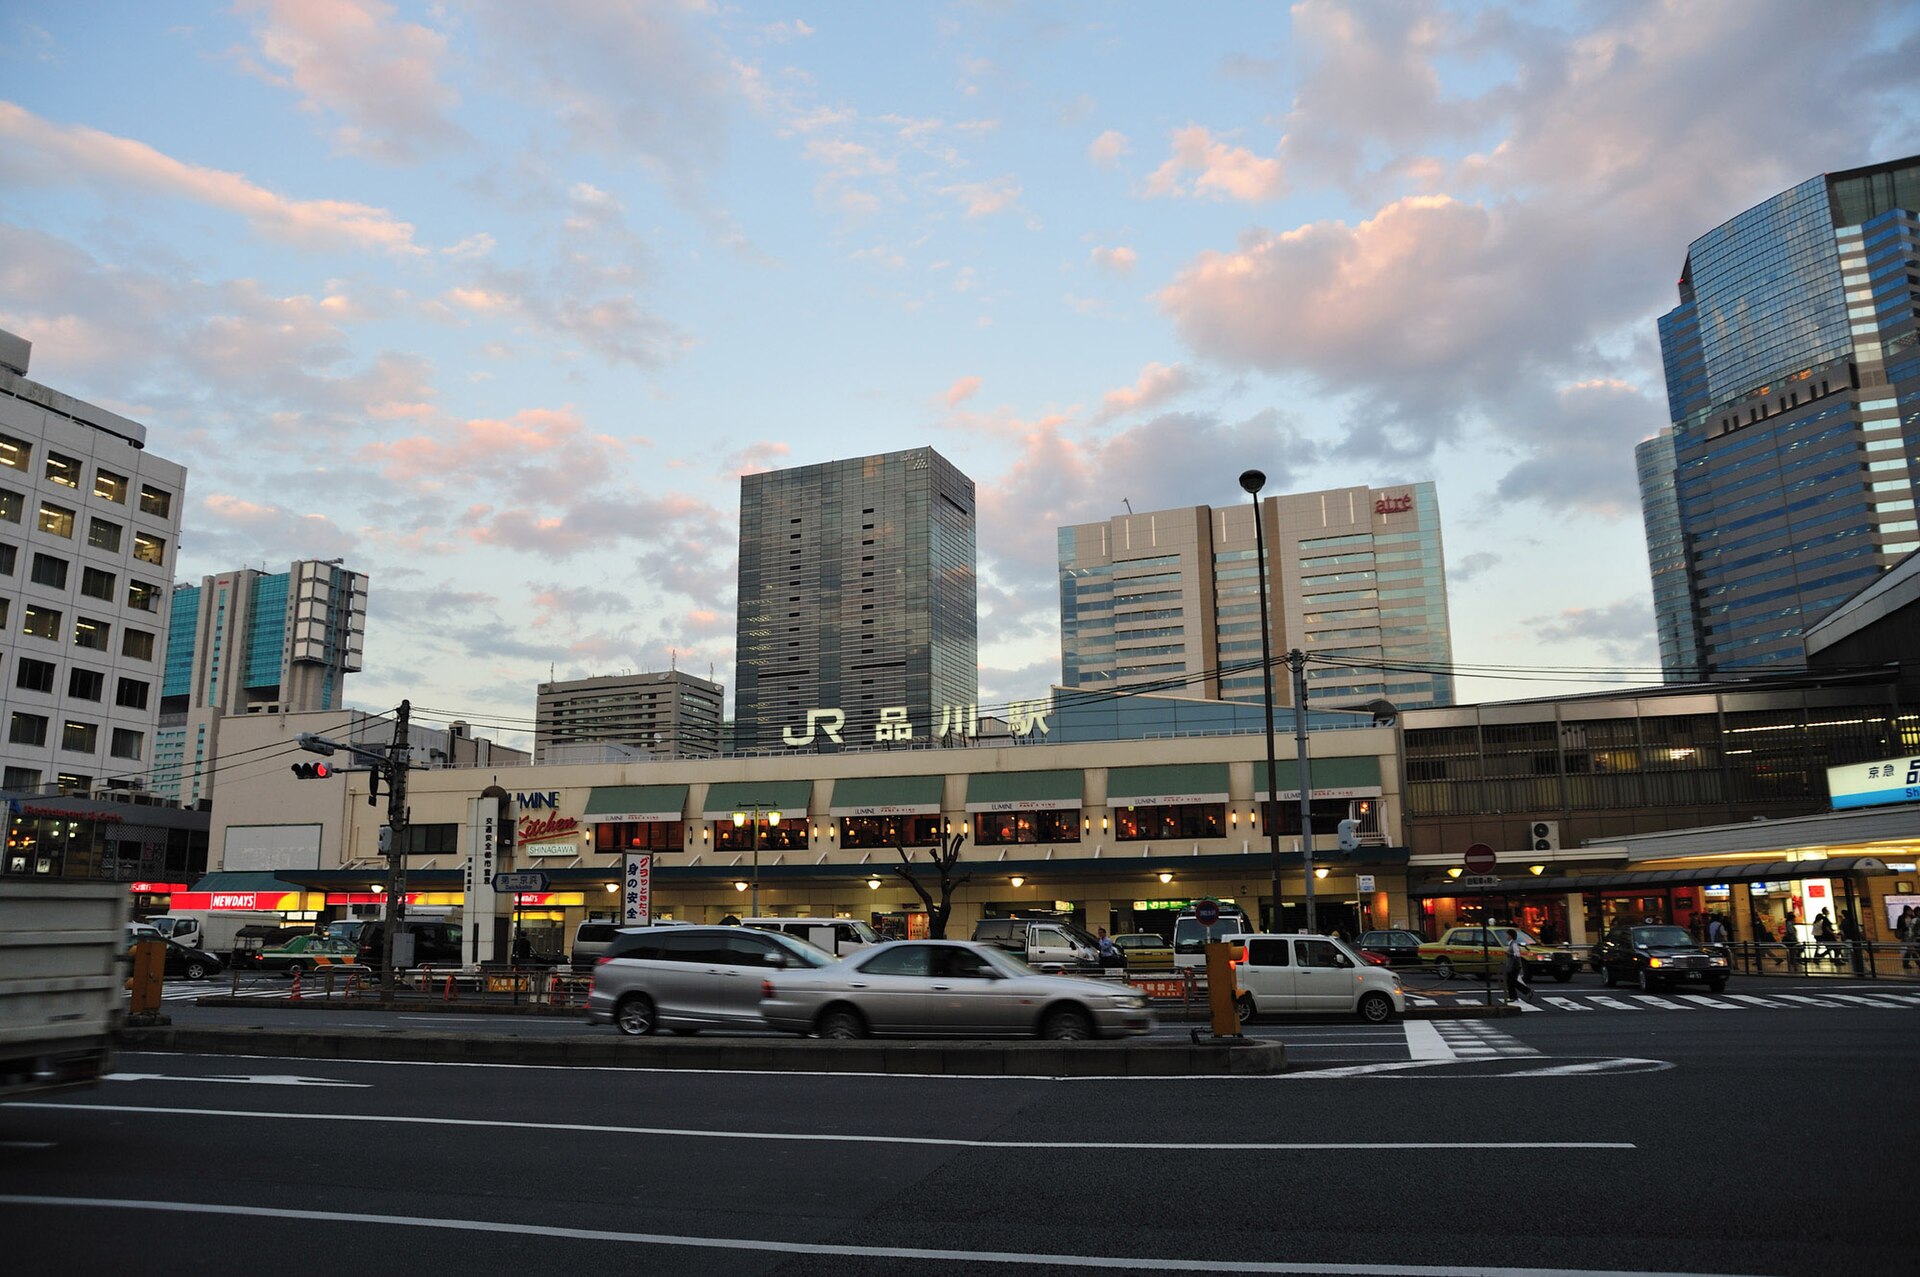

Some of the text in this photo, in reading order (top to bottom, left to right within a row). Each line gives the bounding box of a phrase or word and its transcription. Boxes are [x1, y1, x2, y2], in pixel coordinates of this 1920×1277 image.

[783, 699, 1050, 746] JR 品川駅
[1868, 764, 1895, 779] 京急
[529, 845, 574, 854] SHINAGAWA
[626, 862, 638, 919] 身の安全
[213, 895, 253, 907] NEWDAYS
